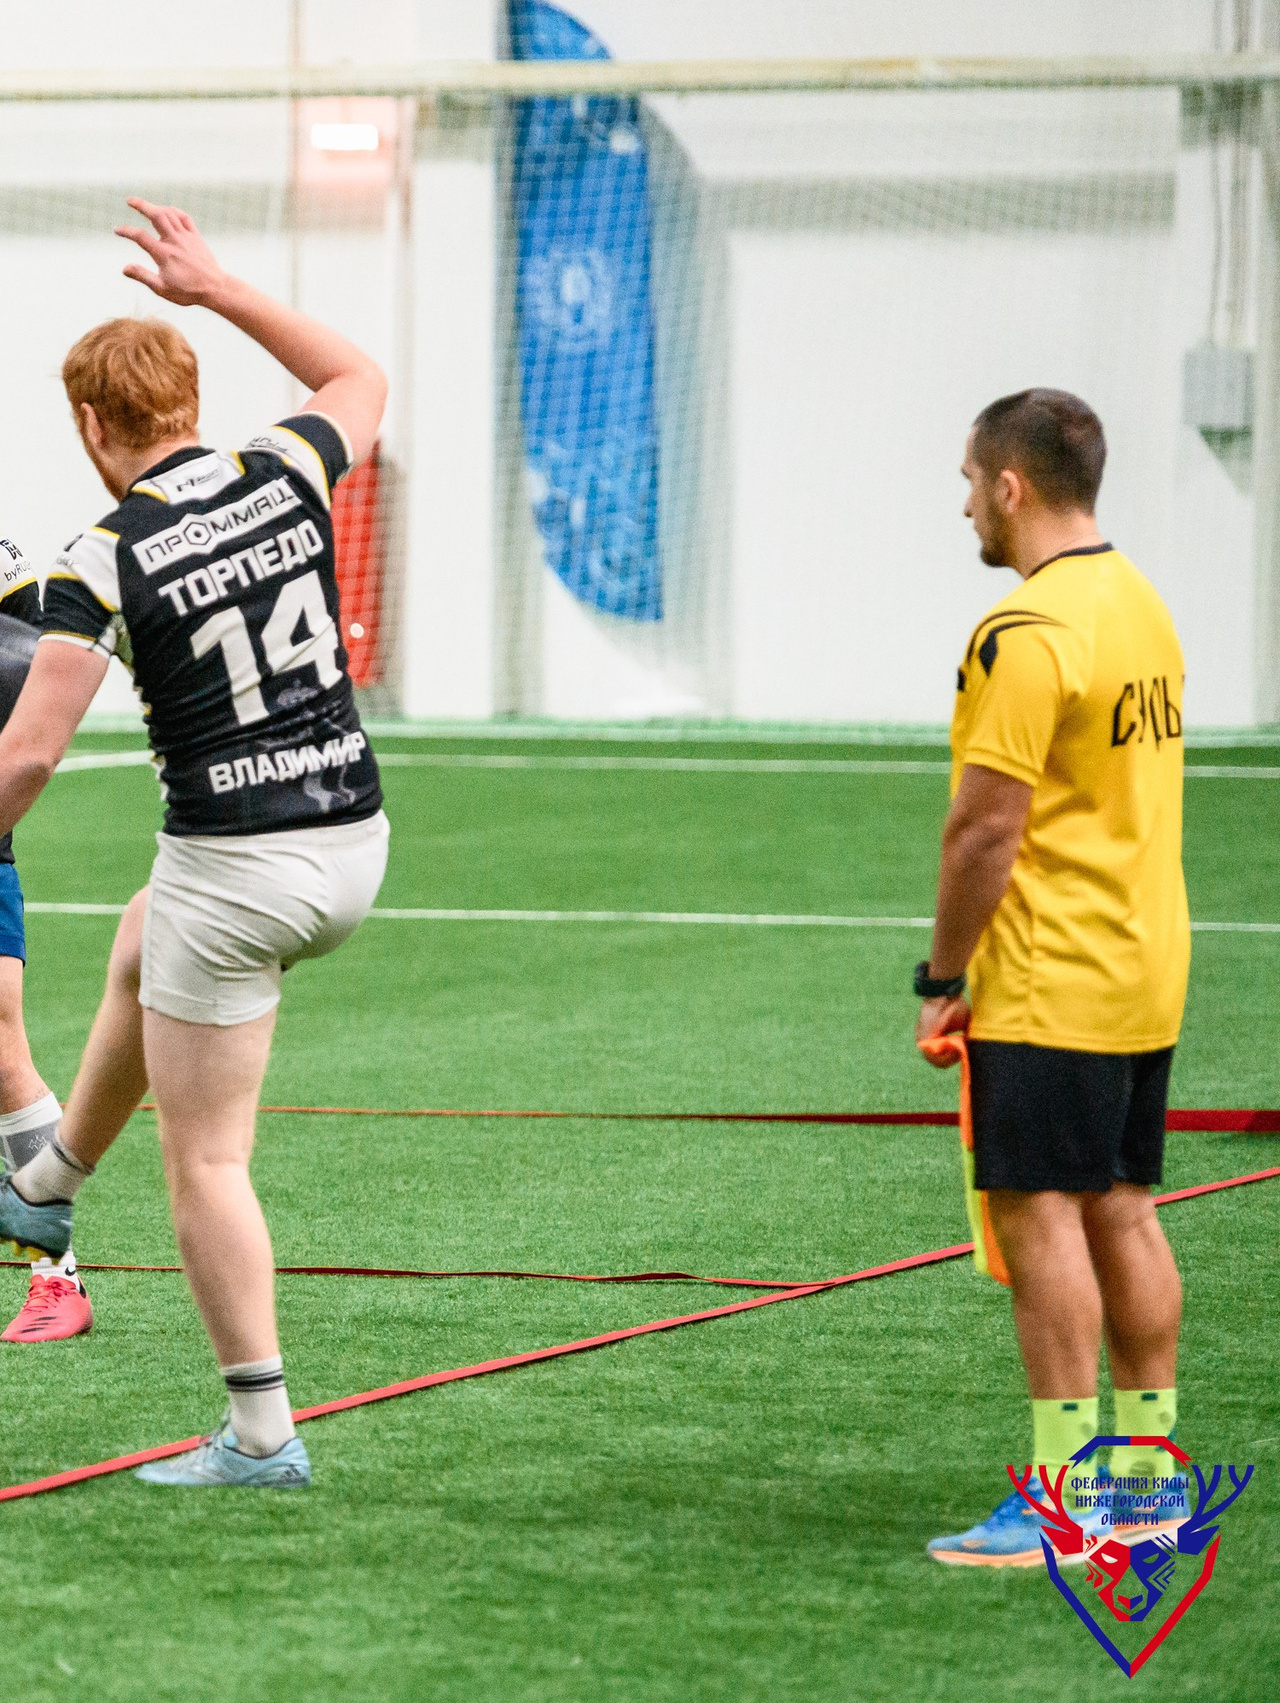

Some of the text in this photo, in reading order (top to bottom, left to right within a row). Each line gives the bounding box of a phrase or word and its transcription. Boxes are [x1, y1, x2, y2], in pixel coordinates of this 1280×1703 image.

[158, 519, 324, 617] ТОРПЕДО
[190, 569, 343, 726] 14
[208, 731, 366, 794] ВЛАДИМИР
